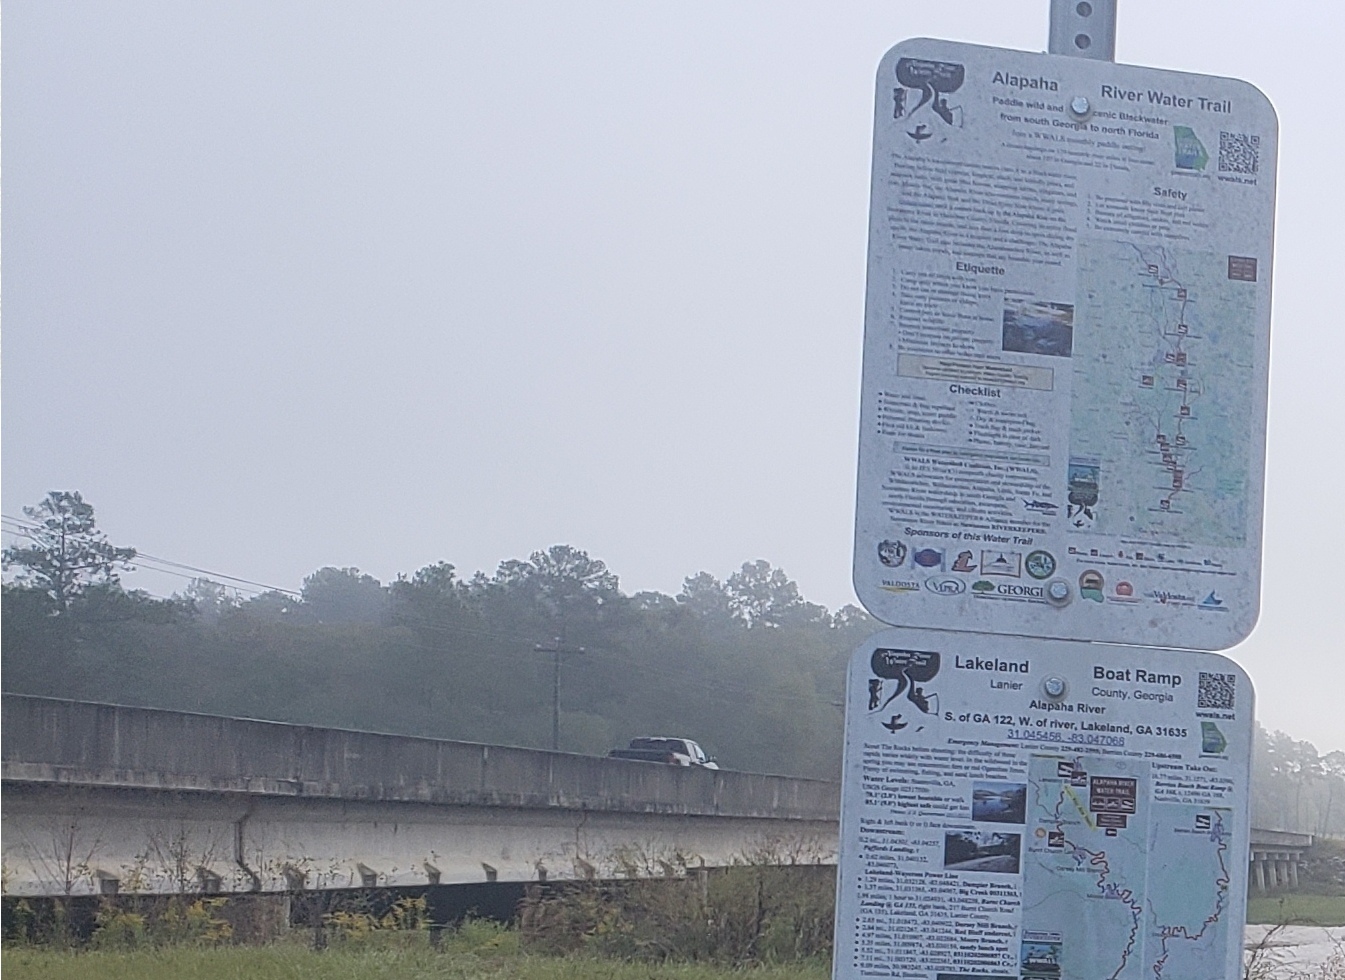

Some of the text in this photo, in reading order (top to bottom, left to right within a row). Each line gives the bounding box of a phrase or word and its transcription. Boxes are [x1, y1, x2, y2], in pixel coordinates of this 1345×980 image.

[992, 71, 1231, 113] Alapaha River Water Trail
[992, 96, 1168, 126] Paddle wild and cenic Blackwater
[1000, 113, 1160, 140] from south Georgia to north Florida
[1154, 187, 1187, 201] Safety
[956, 262, 1005, 276] Etiquette
[950, 384, 1001, 398] Checklist
[905, 528, 1033, 546] Sponsors of this Water Trail
[996, 583, 1044, 598] GEORGI
[955, 655, 1181, 688] Lakeland Boat Ramp
[990, 679, 1173, 704] Lanier County, Georgia
[1029, 700, 1106, 714] Alapaha River
[945, 711, 1187, 738] S. of GA 122, W. of river, Lakeland, GA 31635
[863, 774, 884, 783] Water
